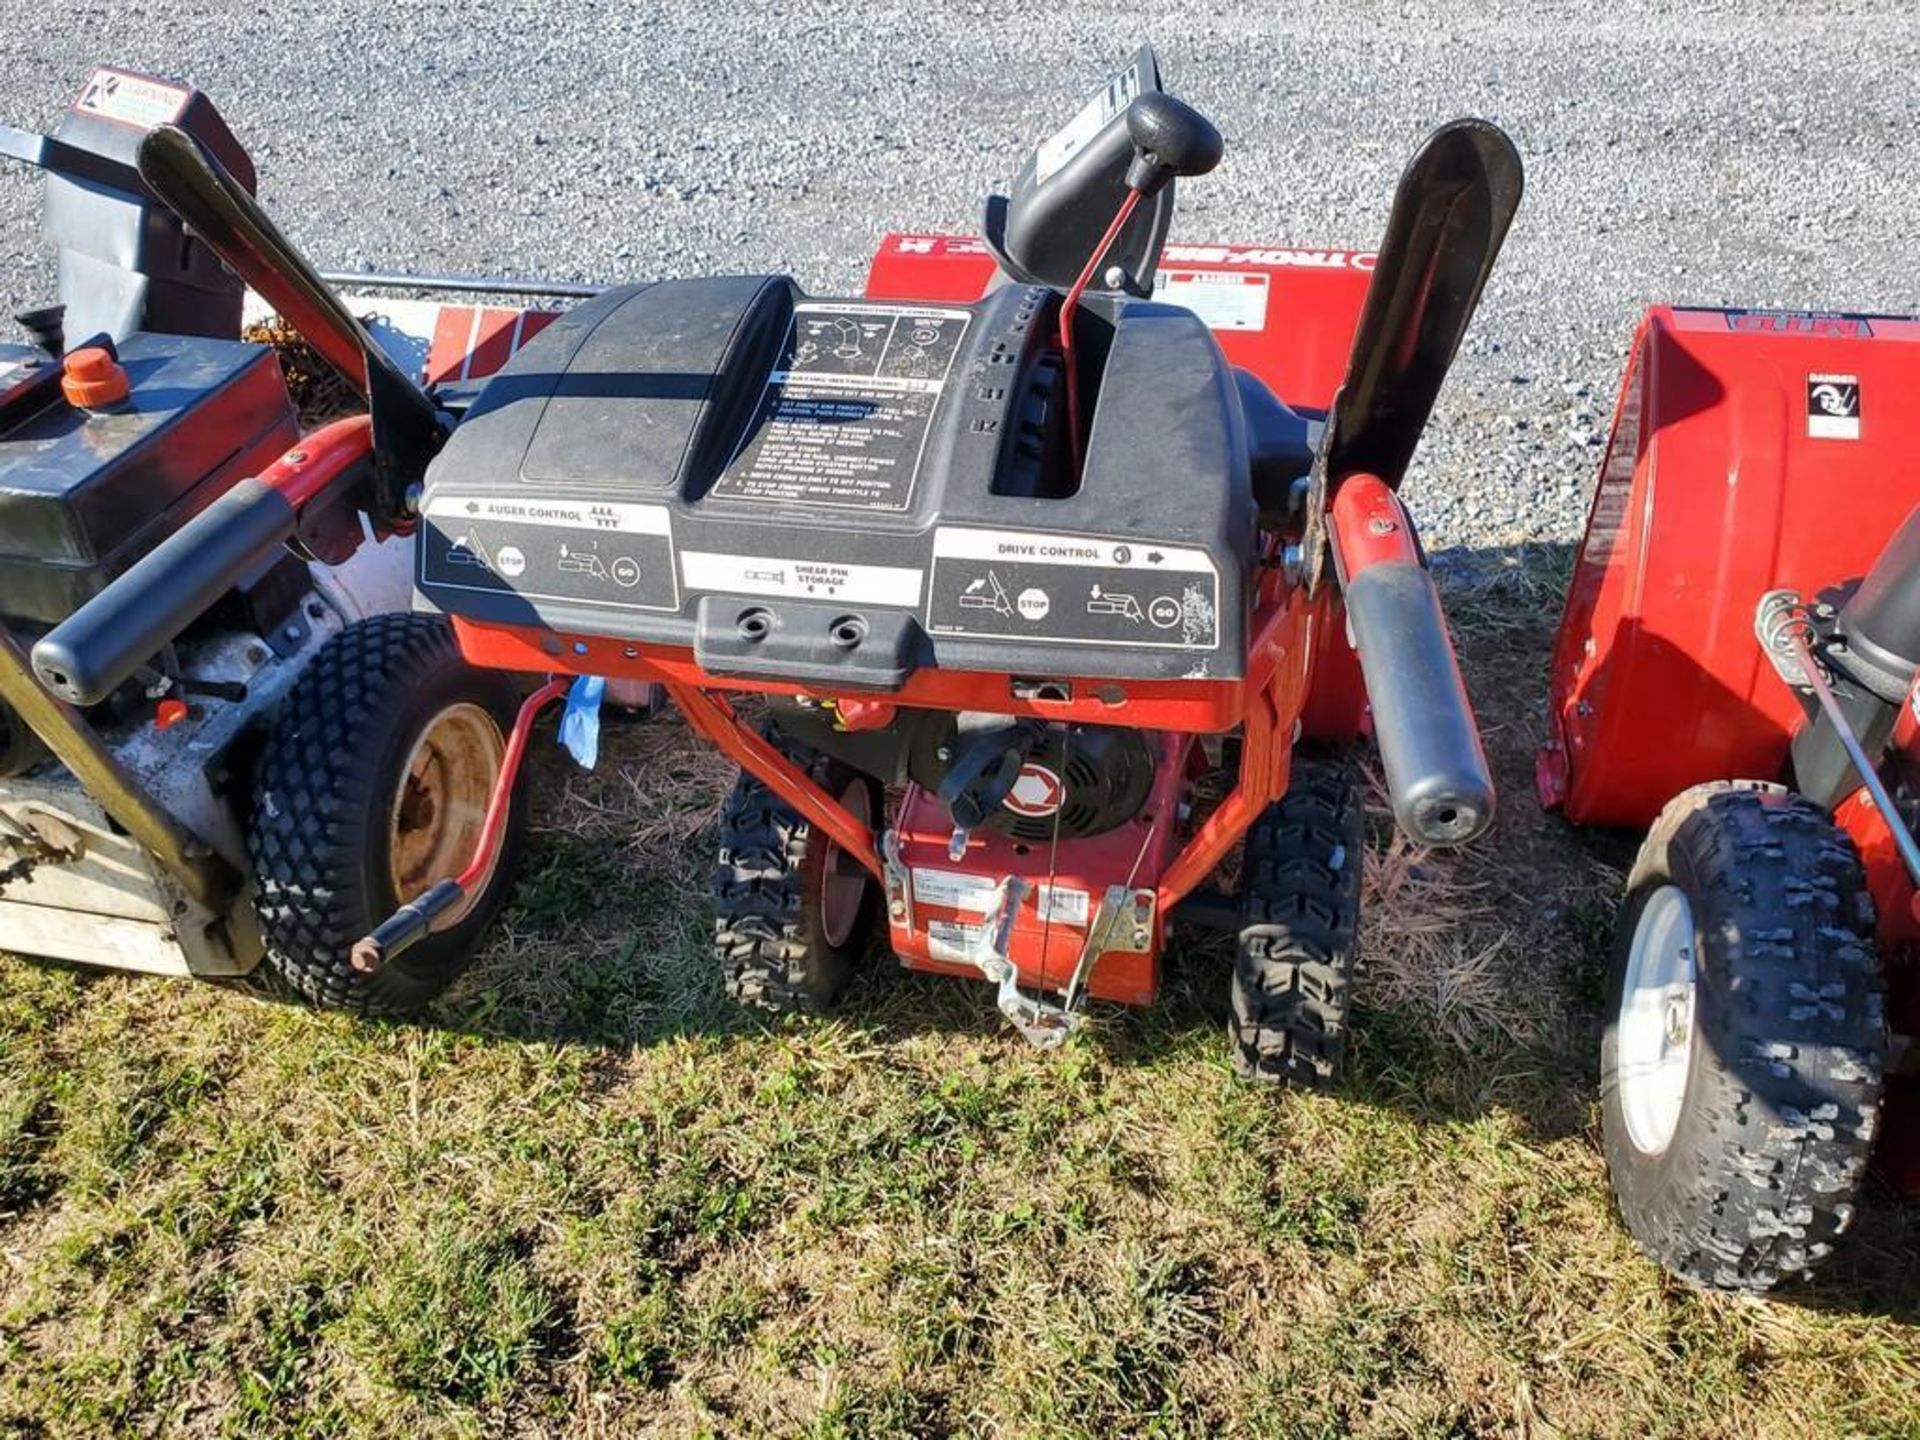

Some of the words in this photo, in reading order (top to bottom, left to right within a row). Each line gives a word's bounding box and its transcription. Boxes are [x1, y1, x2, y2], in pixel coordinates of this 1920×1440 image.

[1808, 373, 1858, 384] DANGER
[488, 504, 526, 515] AUGER
[528, 507, 582, 521] CONTROL
[998, 543, 1036, 556] DRIVE
[1039, 545, 1100, 560] CONTROL
[499, 557, 523, 566] STOP
[795, 565, 828, 576] SHEAR
[830, 567, 848, 577] PIN
[797, 575, 845, 586] STORAGE
[1020, 599, 1047, 609] STOP
[1155, 607, 1175, 618] GO
